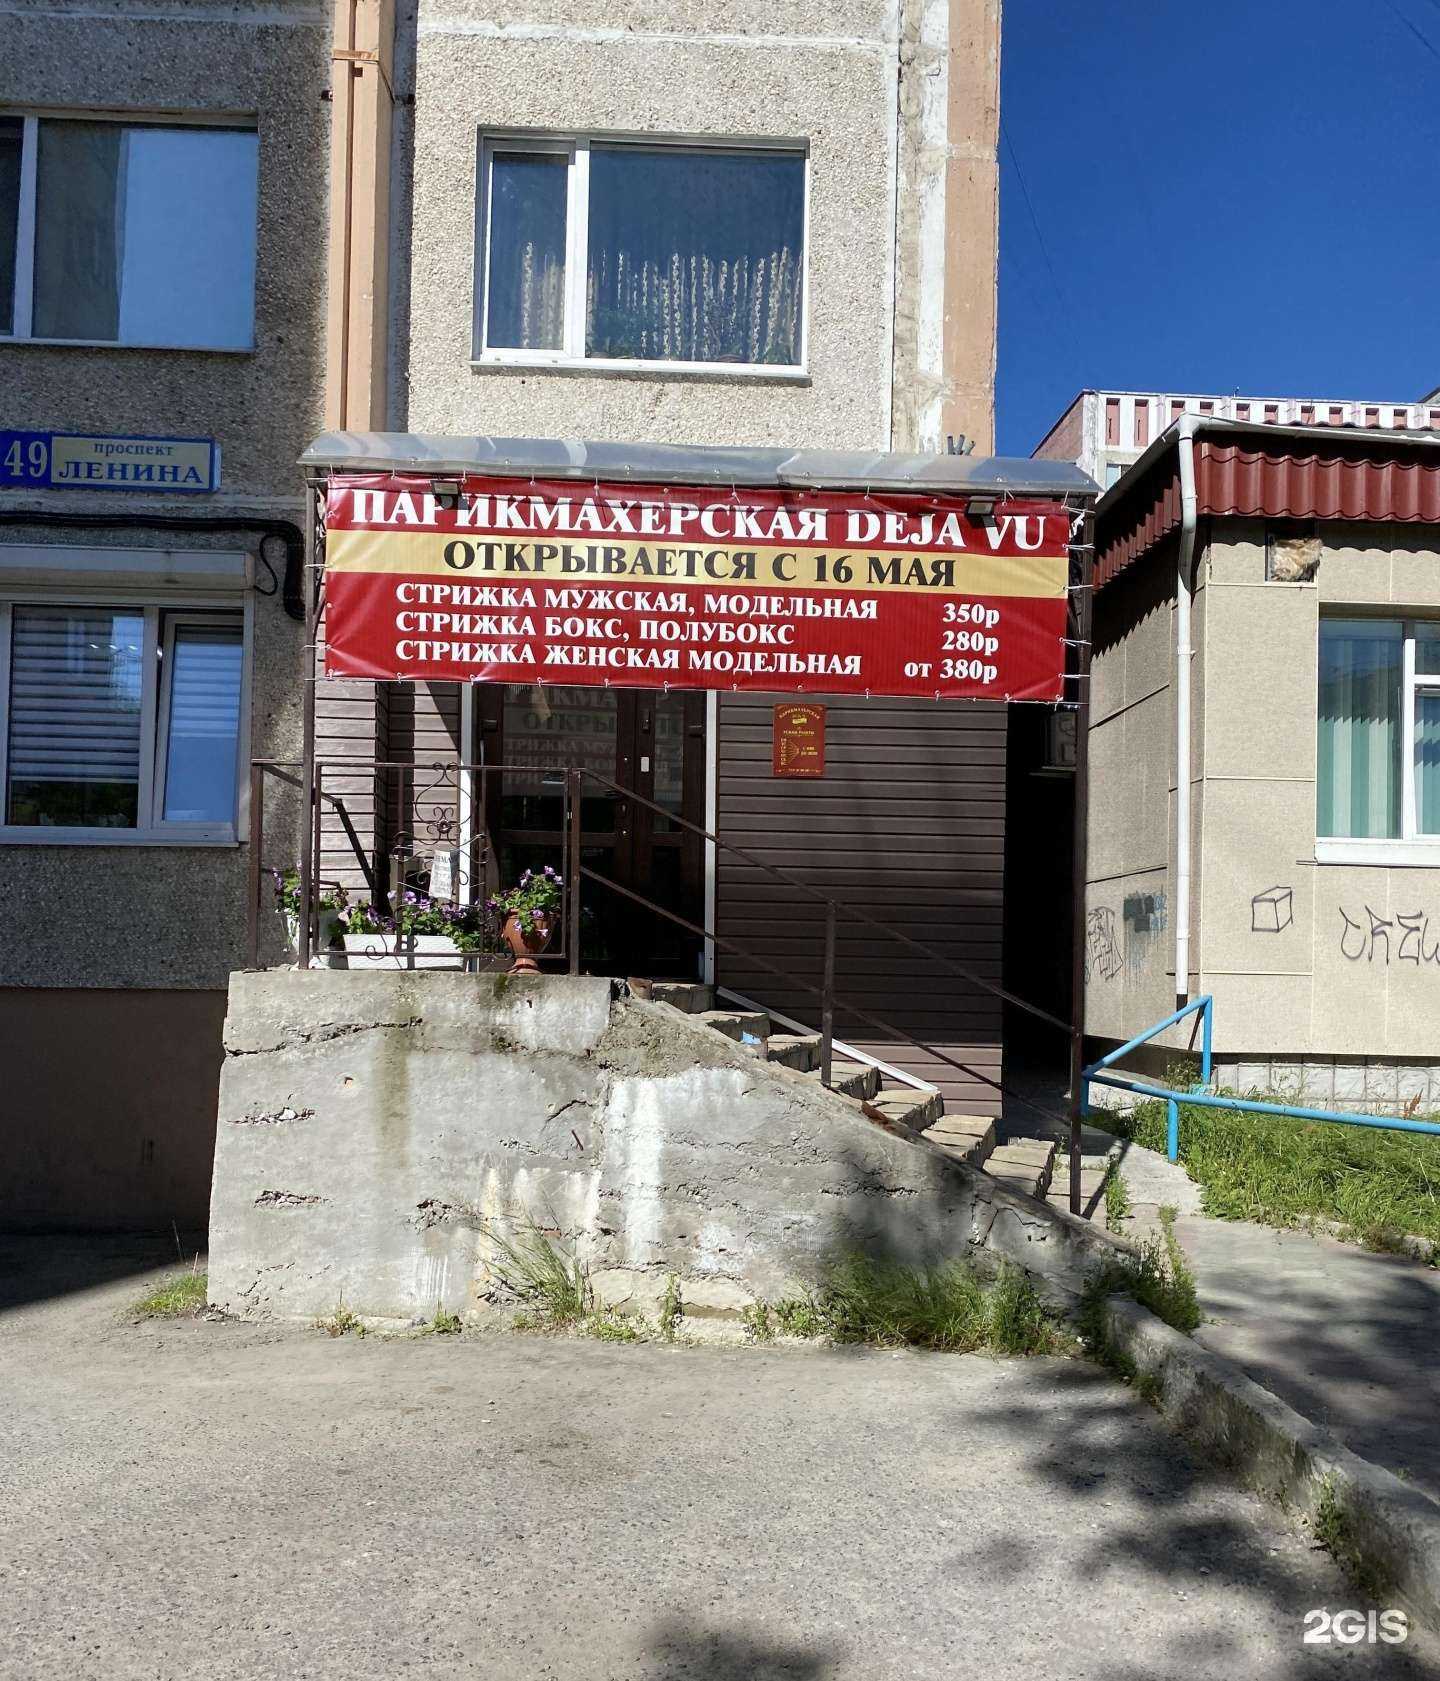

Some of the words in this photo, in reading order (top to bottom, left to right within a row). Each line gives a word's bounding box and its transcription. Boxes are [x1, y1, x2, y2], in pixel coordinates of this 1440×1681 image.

[3, 440, 48, 477] 49
[93, 443, 174, 456] проспект
[58, 461, 204, 484] ЛЕНИНА
[844, 509, 966, 547] DEJA
[987, 514, 1047, 552] VU
[443, 540, 757, 581] ОТКРЫВАЕТСЯ
[771, 552, 798, 582] С
[814, 554, 853, 584] 16
[866, 555, 957, 588] МАЯ
[395, 582, 536, 609] СТРИЖКА
[543, 588, 696, 617] МУЖСКАЯ,
[703, 593, 879, 621] МОДЕЛЬНАЯ
[942, 603, 1000, 629] 350р
[395, 611, 536, 636] СТРИЖКА
[544, 615, 630, 643] БОКС,
[638, 619, 796, 645] ПОЛУБОКС
[941, 630, 999, 656] 280р
[395, 640, 536, 664] СТРИЖКА
[543, 644, 681, 670] ЖЕНСКАЯ
[687, 651, 863, 676] МОДЕЛЬНАЯ
[904, 661, 933, 679] от
[939, 658, 998, 685] 380р
